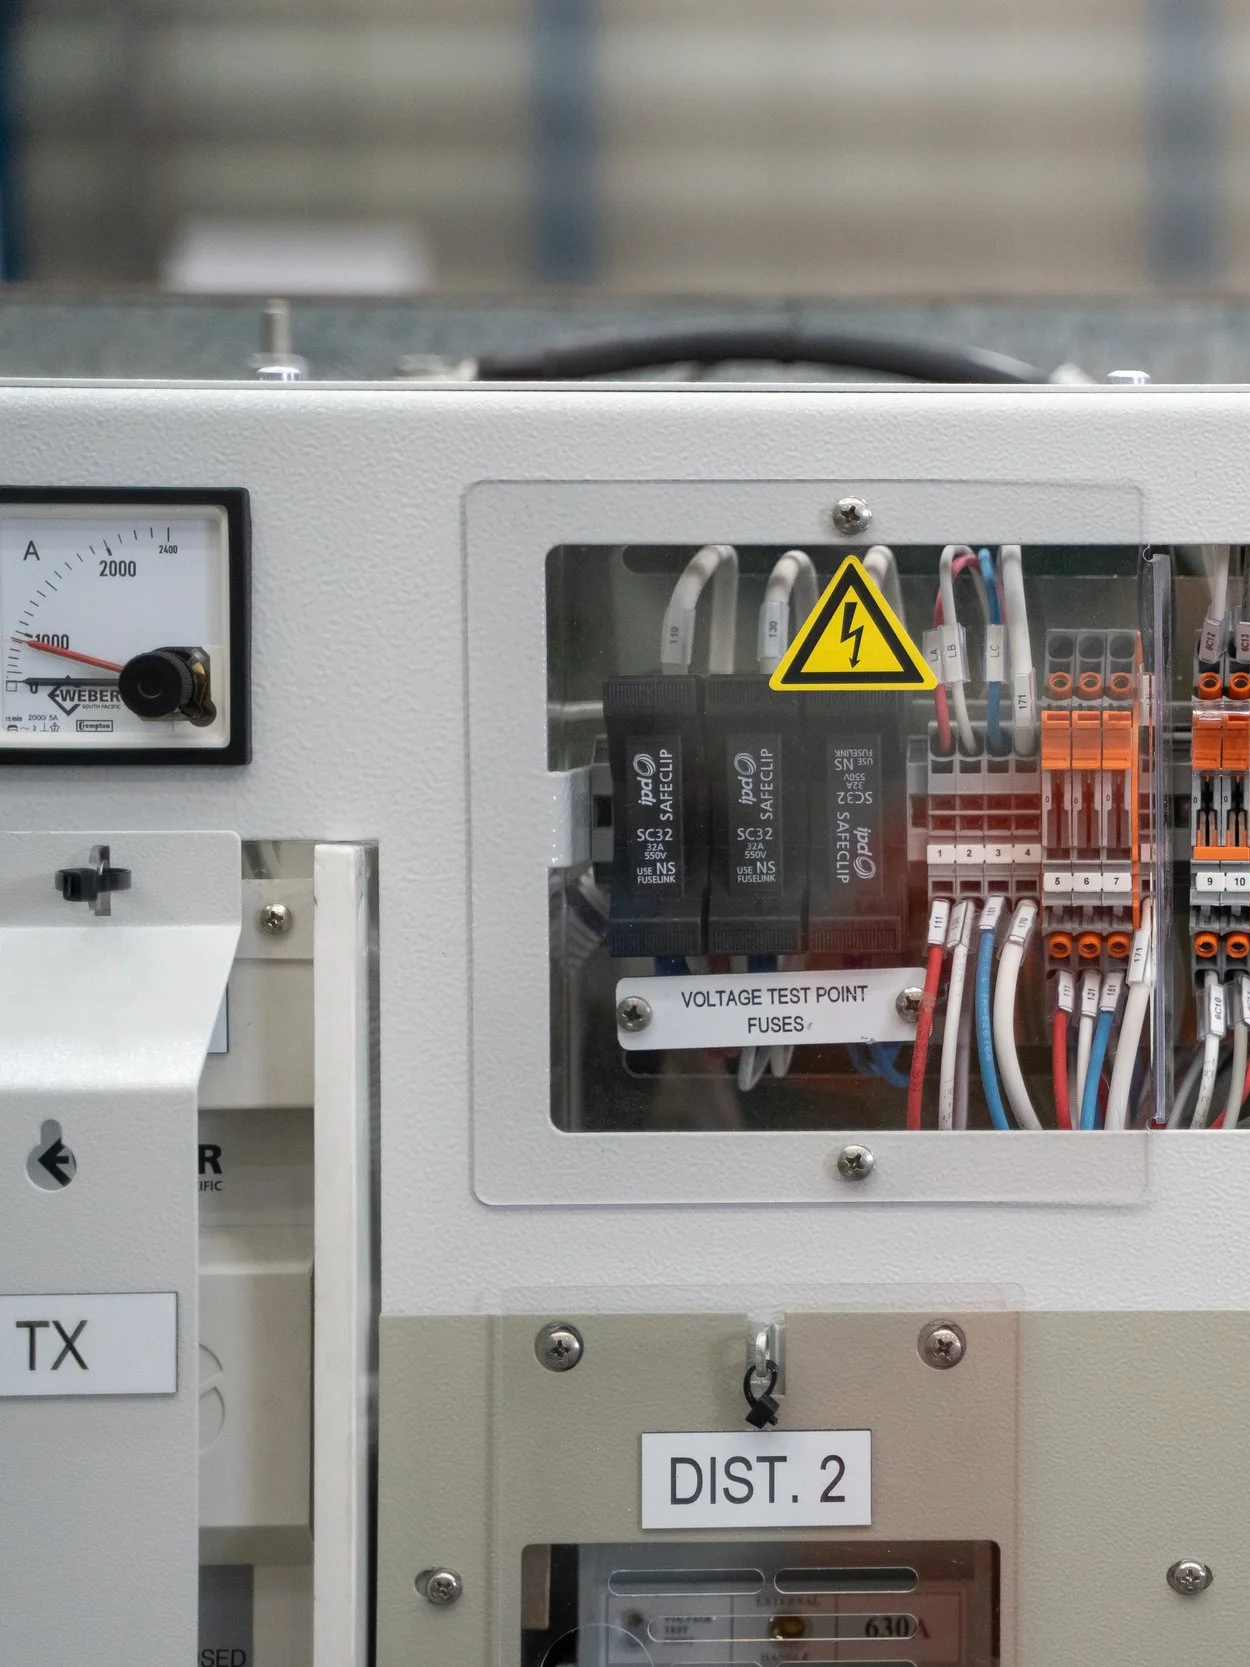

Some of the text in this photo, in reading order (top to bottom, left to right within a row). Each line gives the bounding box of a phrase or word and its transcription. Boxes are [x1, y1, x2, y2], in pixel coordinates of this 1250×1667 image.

[23, 540, 40, 561] A
[158, 545, 178, 554] 2400
[100, 560, 136, 577] 2000
[768, 621, 778, 638] 130
[931, 648, 938, 661] LA
[947, 644, 957, 658] LB
[990, 644, 1000, 658] LC
[60, 689, 121, 702] WEBER
[1018, 694, 1027, 710] 171
[834, 749, 872, 757] FUSELINK
[834, 758, 854, 770] NS
[660, 749, 673, 820] SAFECLIP
[738, 776, 756, 805] ipd
[760, 748, 773, 820] SAFECLIP
[637, 777, 656, 806] ipd
[837, 792, 872, 804] SC32
[637, 829, 673, 841] SC32
[737, 828, 773, 840] SC32
[837, 812, 850, 883] SAFECLIP
[937, 849, 942, 857] 1
[966, 849, 972, 857] 2
[995, 848, 1001, 857] 3
[656, 862, 676, 875] NS
[756, 861, 776, 874] NS
[638, 875, 676, 884] FUSELINK
[738, 874, 776, 883] FUSELINK
[1207, 878, 1213, 886] 9
[1235, 878, 1246, 886] 10
[1018, 917, 1028, 928] 170
[1134, 947, 1143, 962] 171
[681, 985, 868, 1008] VOLTAGE TEST POINT
[1087, 988, 1096, 1000] 131
[1107, 984, 1116, 996] 151
[748, 1017, 804, 1034] FUSES
[16, 1320, 88, 1371] TX
[670, 1455, 845, 1504] DIST. 2
[198, 1649, 246, 1667] SED
